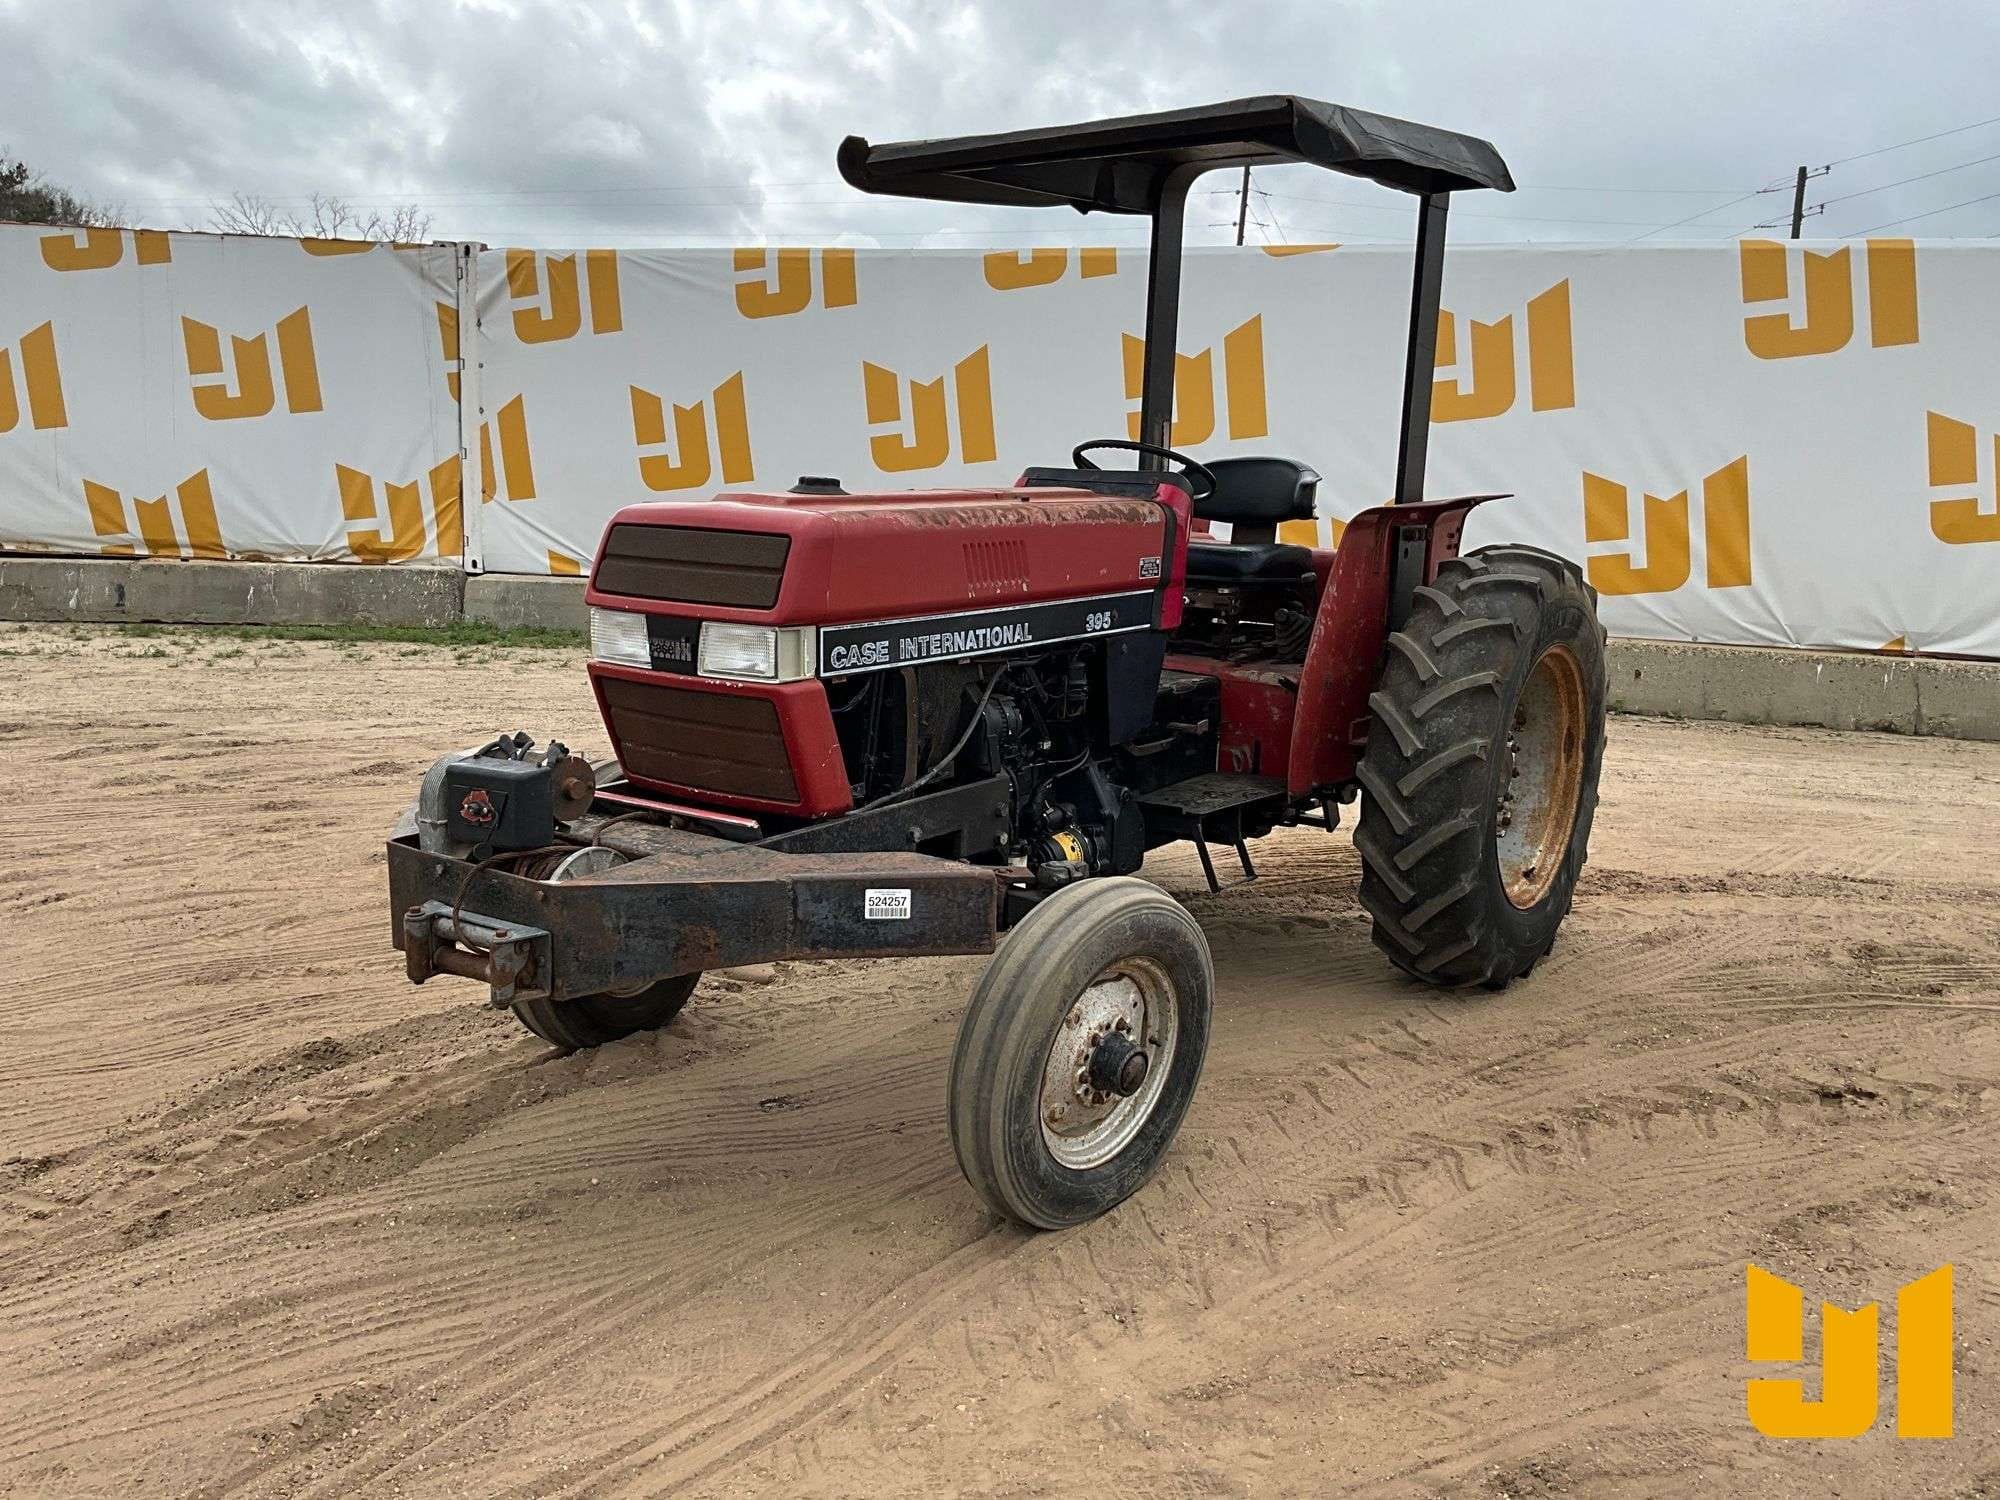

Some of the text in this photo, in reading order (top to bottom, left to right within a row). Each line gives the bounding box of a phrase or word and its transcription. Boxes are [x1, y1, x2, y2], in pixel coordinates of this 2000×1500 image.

[830, 611, 1111, 668] CASE INTERNATIONAL 395
[868, 896, 907, 907] 524257
